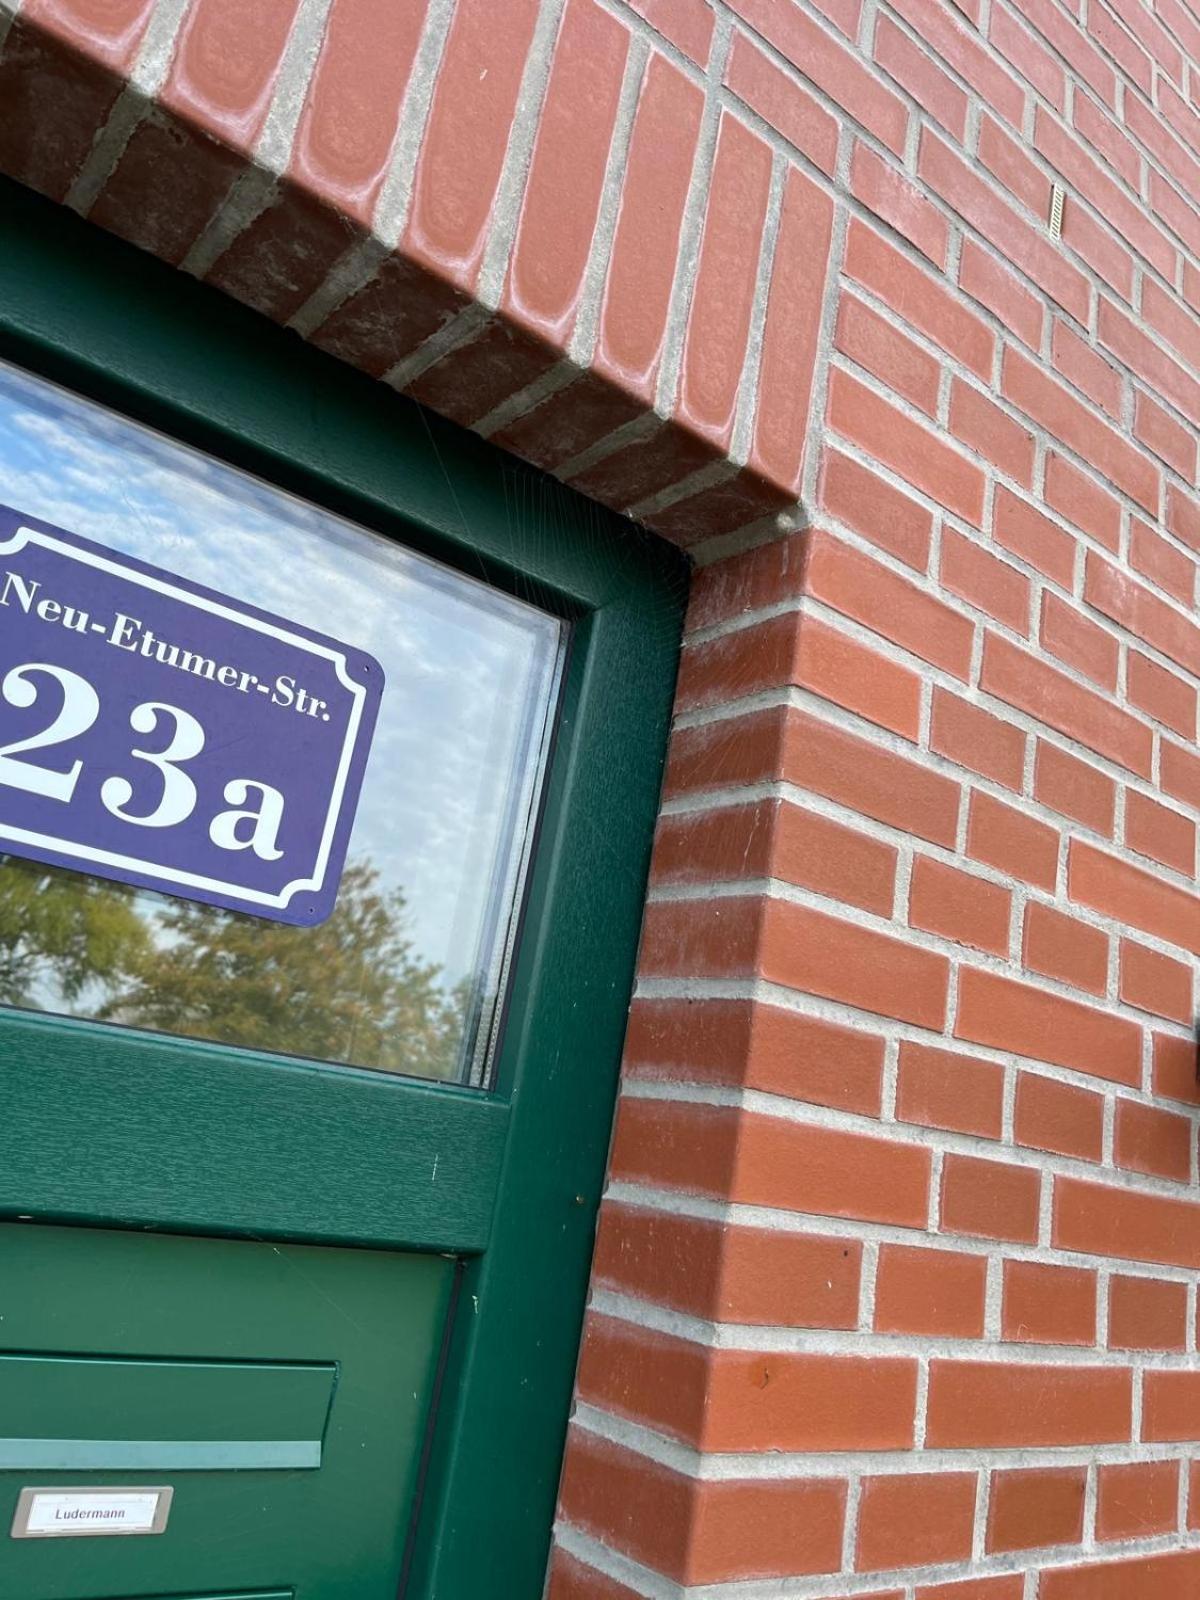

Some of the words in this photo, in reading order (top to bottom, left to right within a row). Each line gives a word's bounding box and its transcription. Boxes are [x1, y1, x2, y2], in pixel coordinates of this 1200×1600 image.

[0, 571, 331, 721] Neu-Etumer-Str.
[0, 662, 285, 861] 23a
[55, 1508, 125, 1520] Ludermann
